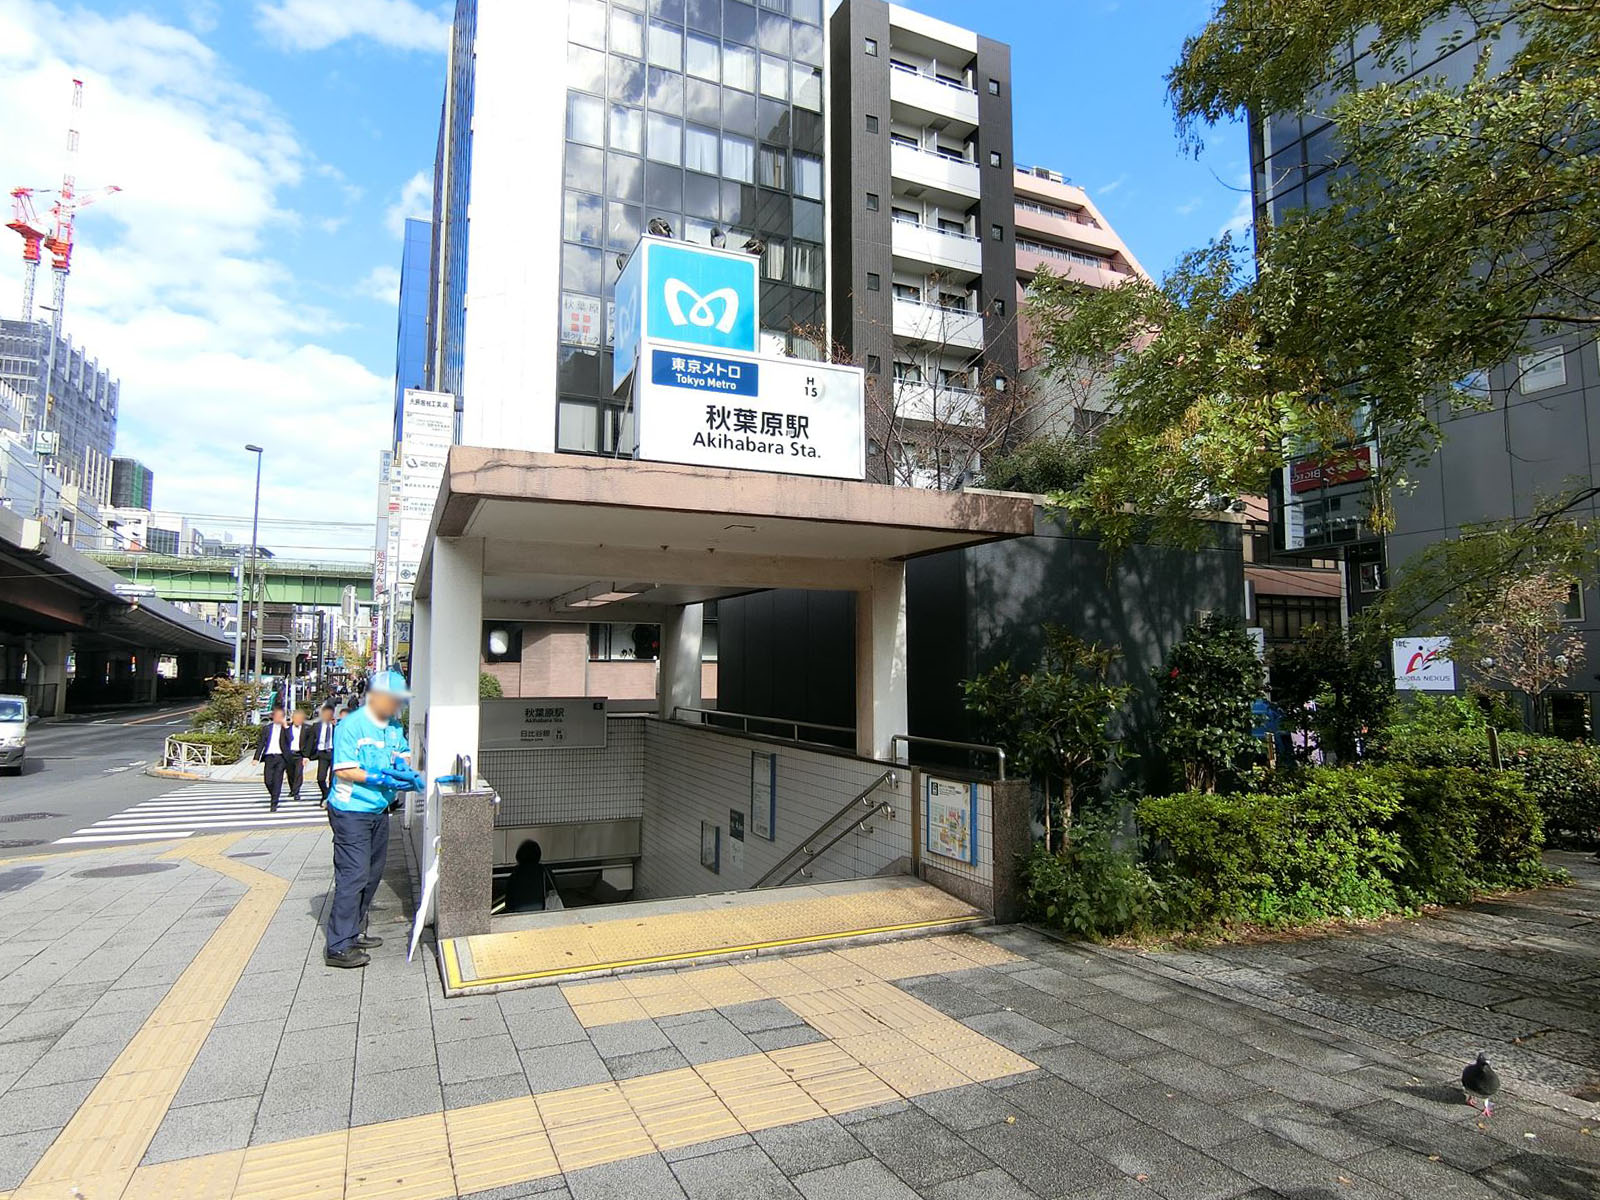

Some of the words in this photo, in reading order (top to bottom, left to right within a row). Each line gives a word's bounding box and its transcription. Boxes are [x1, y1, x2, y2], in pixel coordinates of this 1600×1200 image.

[671, 356, 741, 379] 東京メトロ
[675, 373, 705, 387] Tokyo
[707, 377, 737, 390] Metro
[806, 376, 814, 385] H
[804, 386, 818, 397] 15
[705, 404, 809, 439] 秋葉原駅
[692, 431, 784, 455] Akihabara
[790, 441, 821, 458] Sta.
[524, 707, 565, 717] 秋葉原駅
